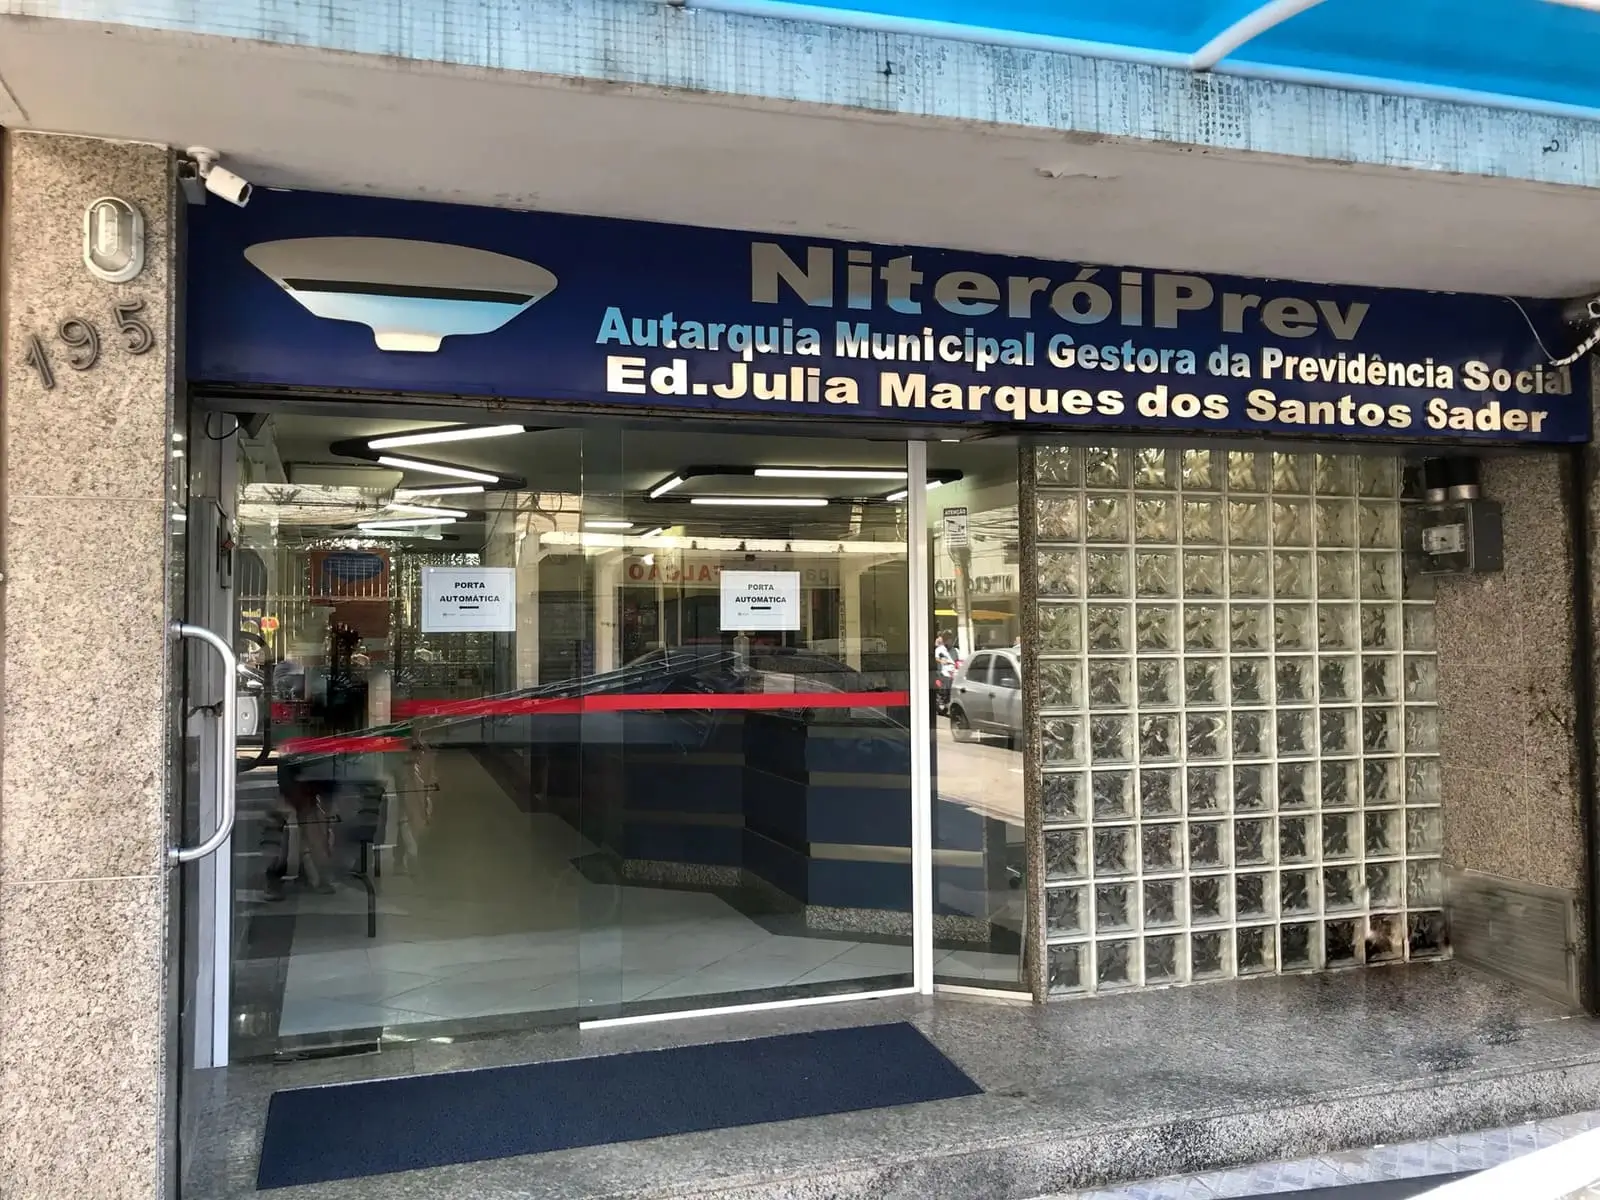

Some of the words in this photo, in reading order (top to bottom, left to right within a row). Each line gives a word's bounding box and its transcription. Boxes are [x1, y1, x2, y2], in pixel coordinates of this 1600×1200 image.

[751, 241, 1371, 341] NiteróiPrev
[25, 299, 154, 390] 195
[595, 306, 821, 362] Autarquia
[835, 320, 1035, 372] Municipal
[1048, 333, 1196, 376] Gestora
[1208, 343, 1251, 379] da
[1262, 347, 1454, 390] Previdência
[1462, 360, 1573, 395] Social
[879, 371, 1126, 421] Marques
[1137, 384, 1230, 420] dos
[1246, 389, 1412, 430] Santos
[1427, 397, 1549, 433] Sader
[454, 581, 486, 589] PORTA
[747, 583, 774, 591] PORTA
